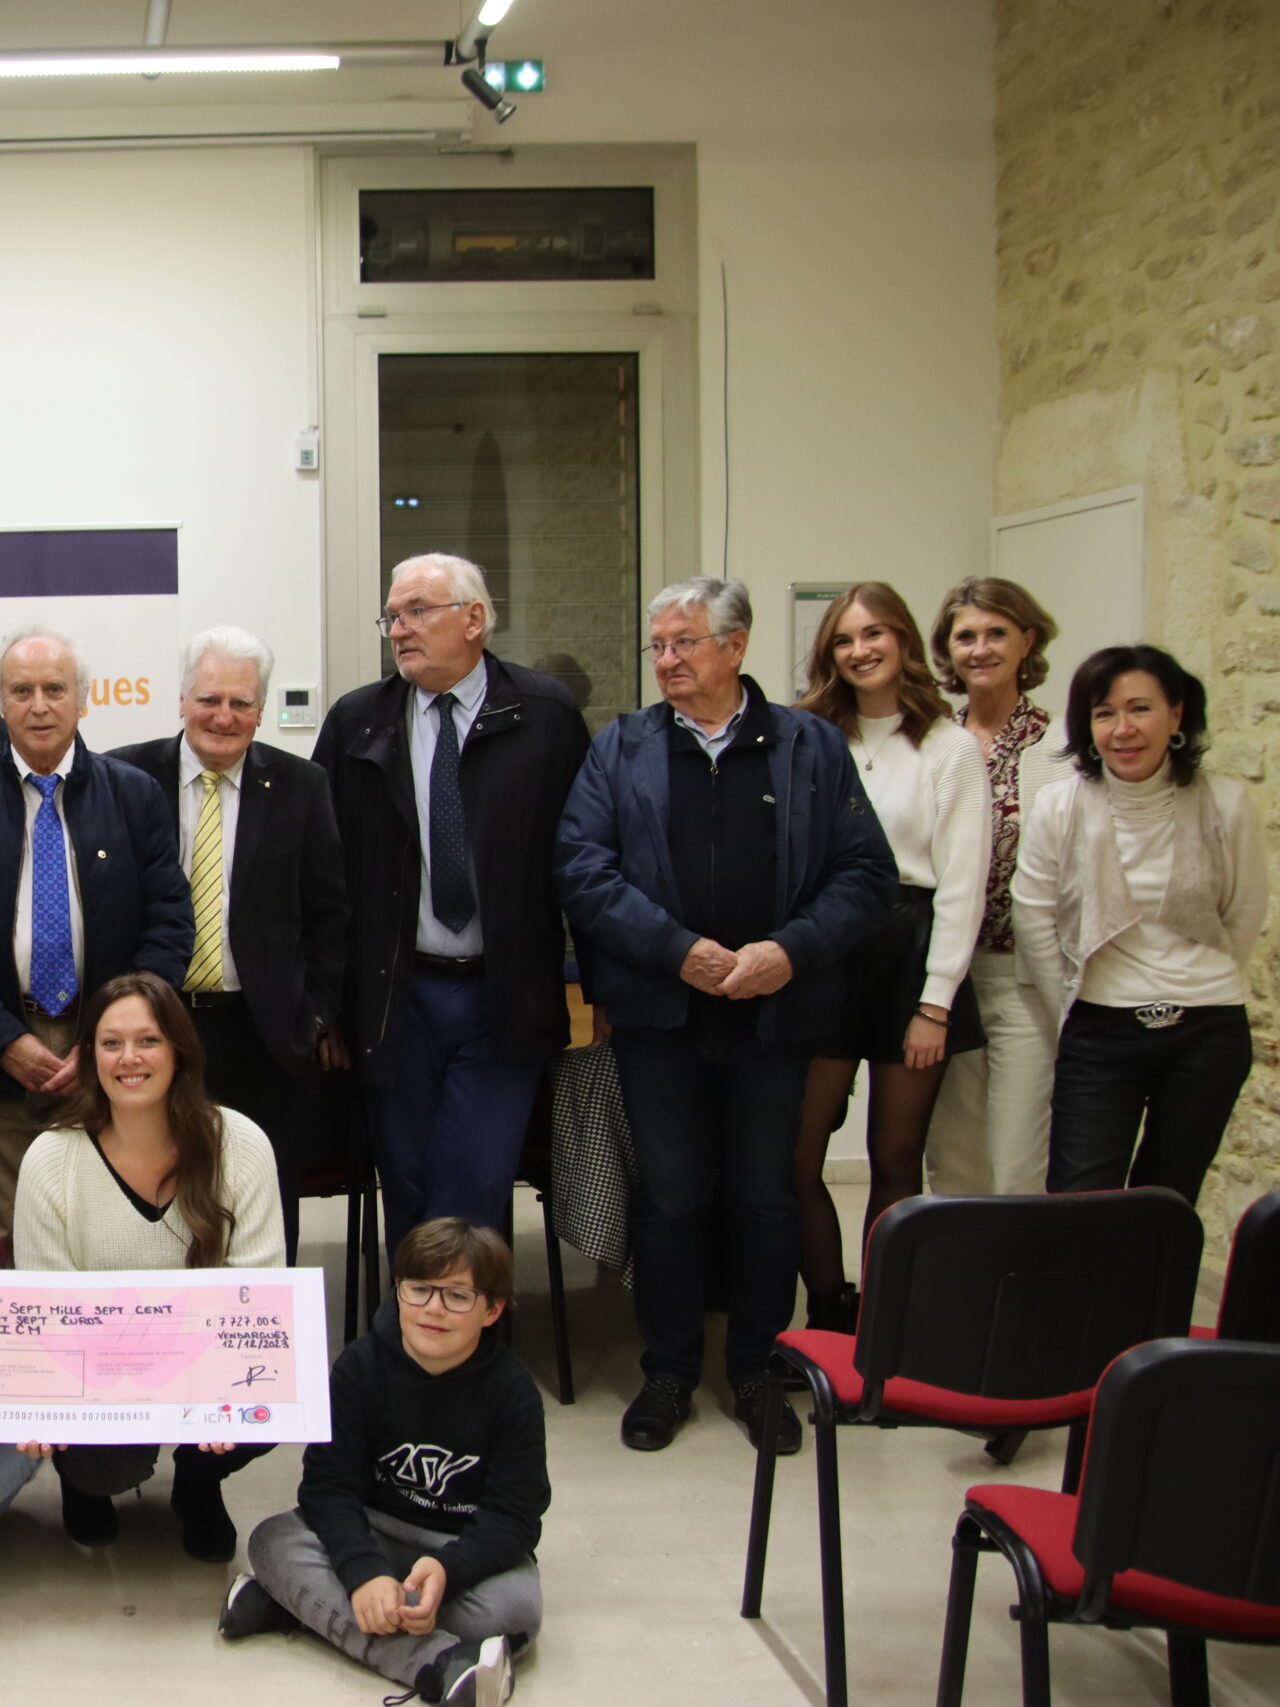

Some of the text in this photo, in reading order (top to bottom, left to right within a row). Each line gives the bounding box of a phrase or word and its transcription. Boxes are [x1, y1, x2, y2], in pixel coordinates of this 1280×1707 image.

[8, 1302, 42, 1315] SEPT
[94, 1305, 124, 1316] SEPT
[134, 1304, 174, 1315] CENT
[15, 1315, 48, 1326] SEPT
[217, 1331, 289, 1340] VENDARGUES
